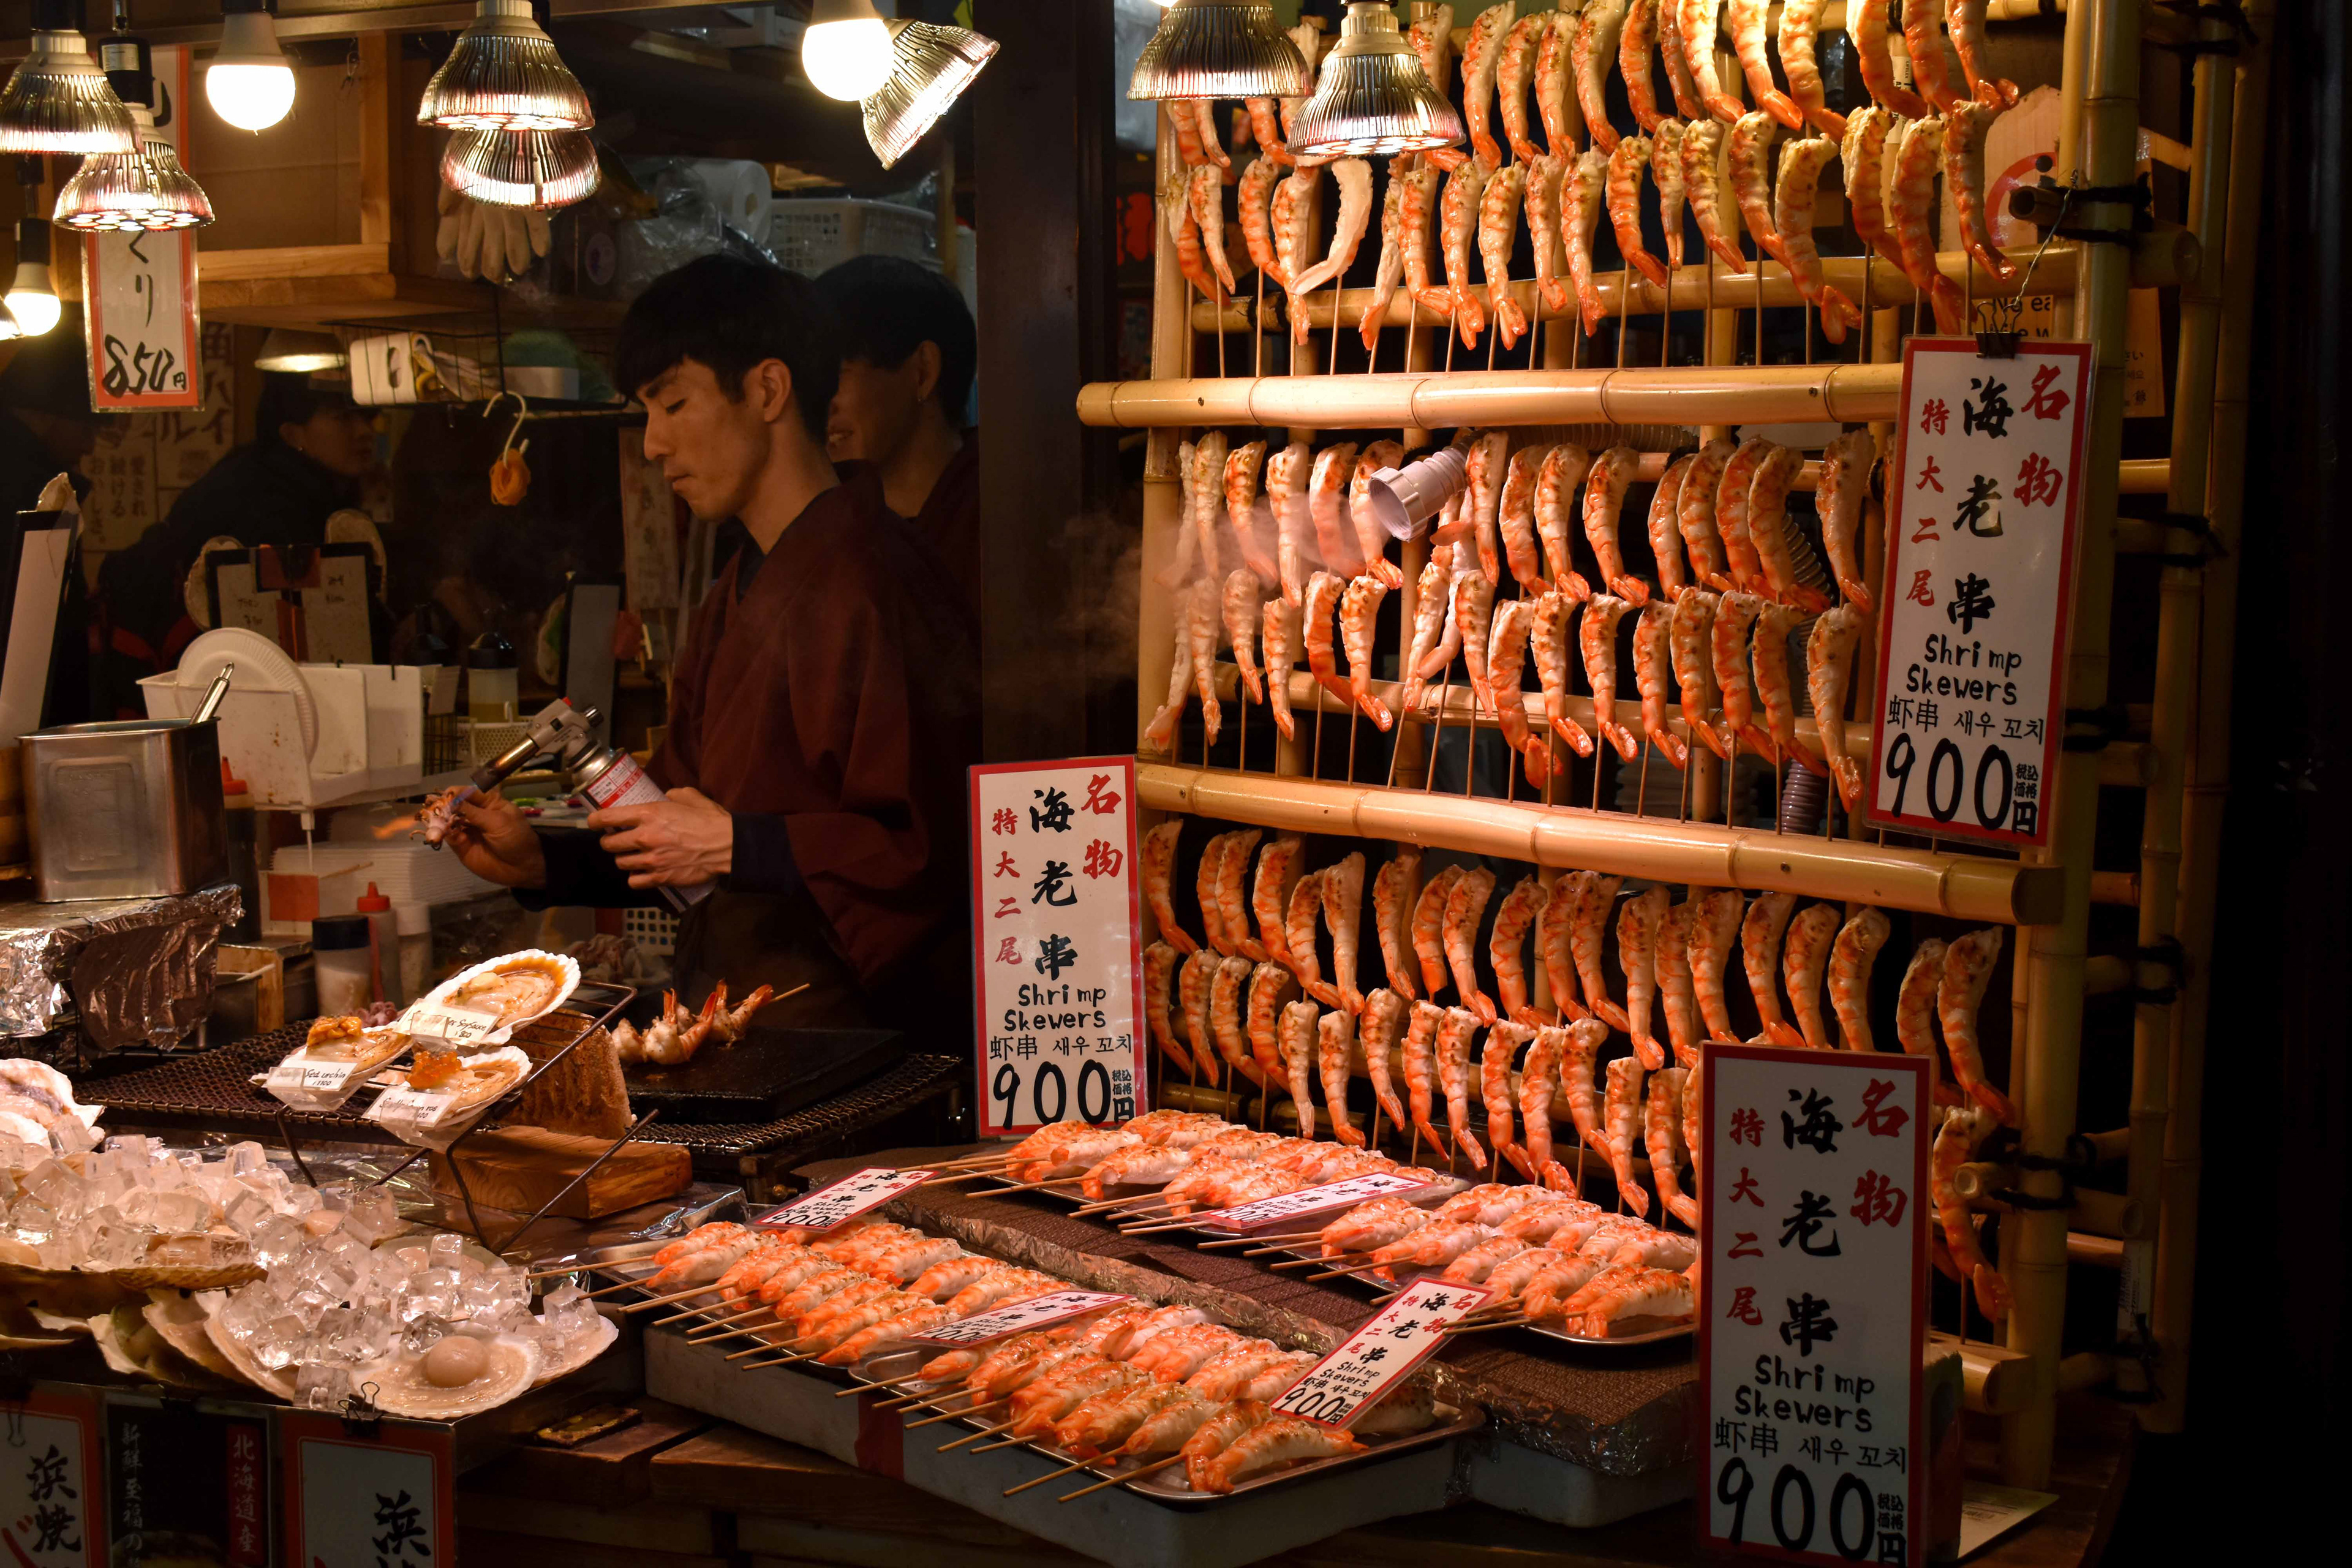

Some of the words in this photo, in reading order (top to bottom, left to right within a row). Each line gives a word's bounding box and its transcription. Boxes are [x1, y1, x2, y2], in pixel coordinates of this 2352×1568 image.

[2013, 363, 2070, 508] 名物
[1905, 399, 1951, 608] 特大二尾
[1946, 375, 2015, 635] 海老串
[1906, 663, 2018, 706] Skewers
[1924, 634, 2022, 670] Shrimp
[1888, 695, 1939, 733] 虾串
[1080, 774, 1123, 880] 名物
[992, 808, 1022, 965] 特大二尾
[1029, 786, 1078, 981] 海老串
[1005, 1009, 1106, 1031] Skewers
[1018, 984, 1106, 1009] Shrimp
[989, 1035, 1038, 1061] 虾串
[1850, 1077, 1910, 1227] 名物
[1726, 1107, 1765, 1325] 特大二尾
[1778, 1087, 1843, 1357] 海老串
[1360, 1292, 1450, 1365] 海老串
[1319, 1368, 1370, 1387] Skewers
[1337, 1361, 1380, 1378] Shrimp
[1754, 1354, 1875, 1403] Shrimp
[1714, 1417, 1779, 1458] 虾串
[1735, 1384, 1872, 1433] Skewers
[27, 1444, 81, 1568] 浜焼
[372, 1490, 431, 1568] 浜
